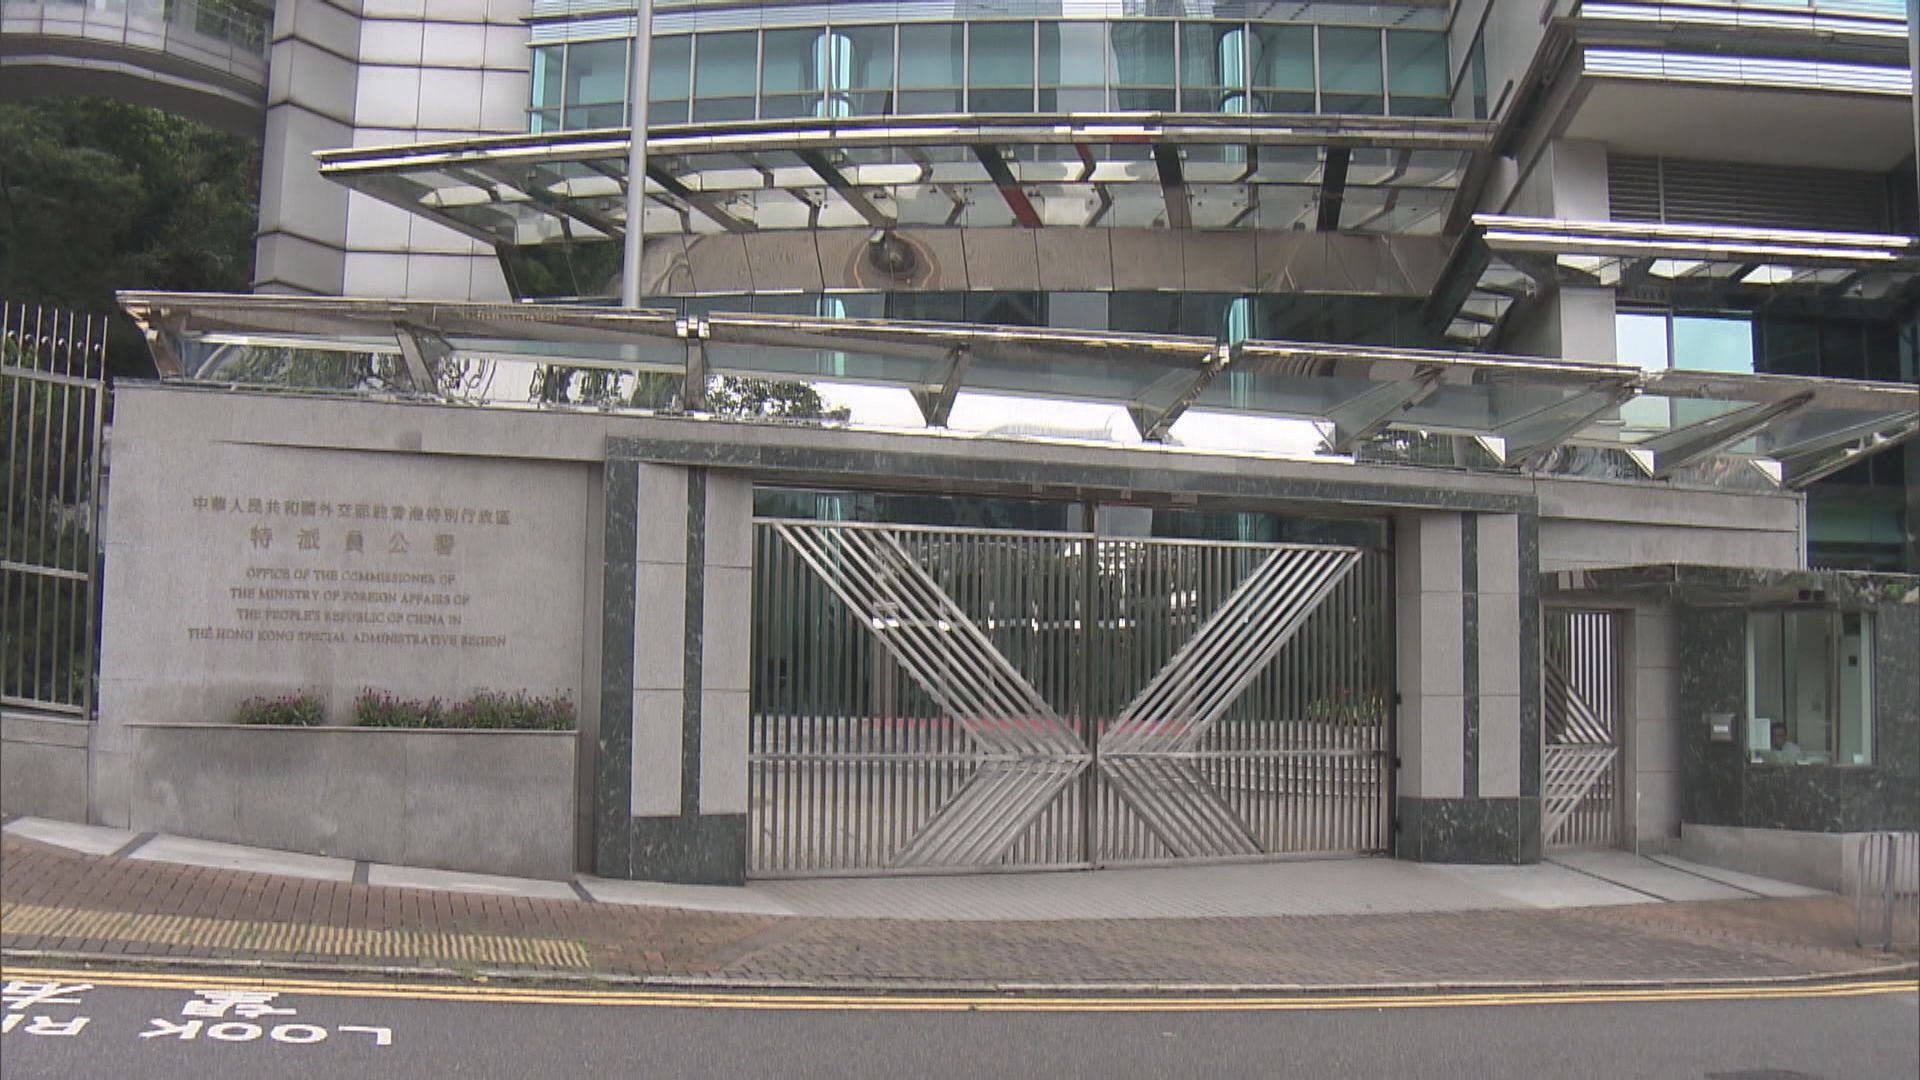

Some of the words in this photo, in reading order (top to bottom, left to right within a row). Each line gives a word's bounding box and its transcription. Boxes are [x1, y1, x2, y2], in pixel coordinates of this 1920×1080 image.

[249, 523, 456, 556] 特派員公署
[246, 567, 290, 580] OFFICE
[294, 568, 310, 580] OF
[313, 569, 338, 582] THE
[341, 570, 435, 584] COMMISSIONER
[439, 573, 456, 585] OF
[230, 587, 255, 600] THE
[259, 588, 319, 601] MINISTRY
[323, 590, 341, 602] OF
[343, 591, 396, 603] FOREIGN
[400, 593, 450, 605] AFFAIRS
[453, 594, 470, 606] OF
[237, 608, 261, 620] THE
[265, 609, 320, 622] PEOPLE'S
[324, 611, 384, 624] REPUBLIC
[387, 612, 403, 624] OF
[406, 613, 444, 625] CHINA
[448, 614, 462, 626] IN
[188, 628, 213, 641] THE
[217, 629, 253, 641] HONG
[258, 630, 293, 642] KONG
[297, 631, 345, 643] SPECIAL
[353, 632, 457, 646] ADMINISTRATIVE
[461, 634, 506, 647] REGION
[139, 1018, 393, 1046] LOOK
